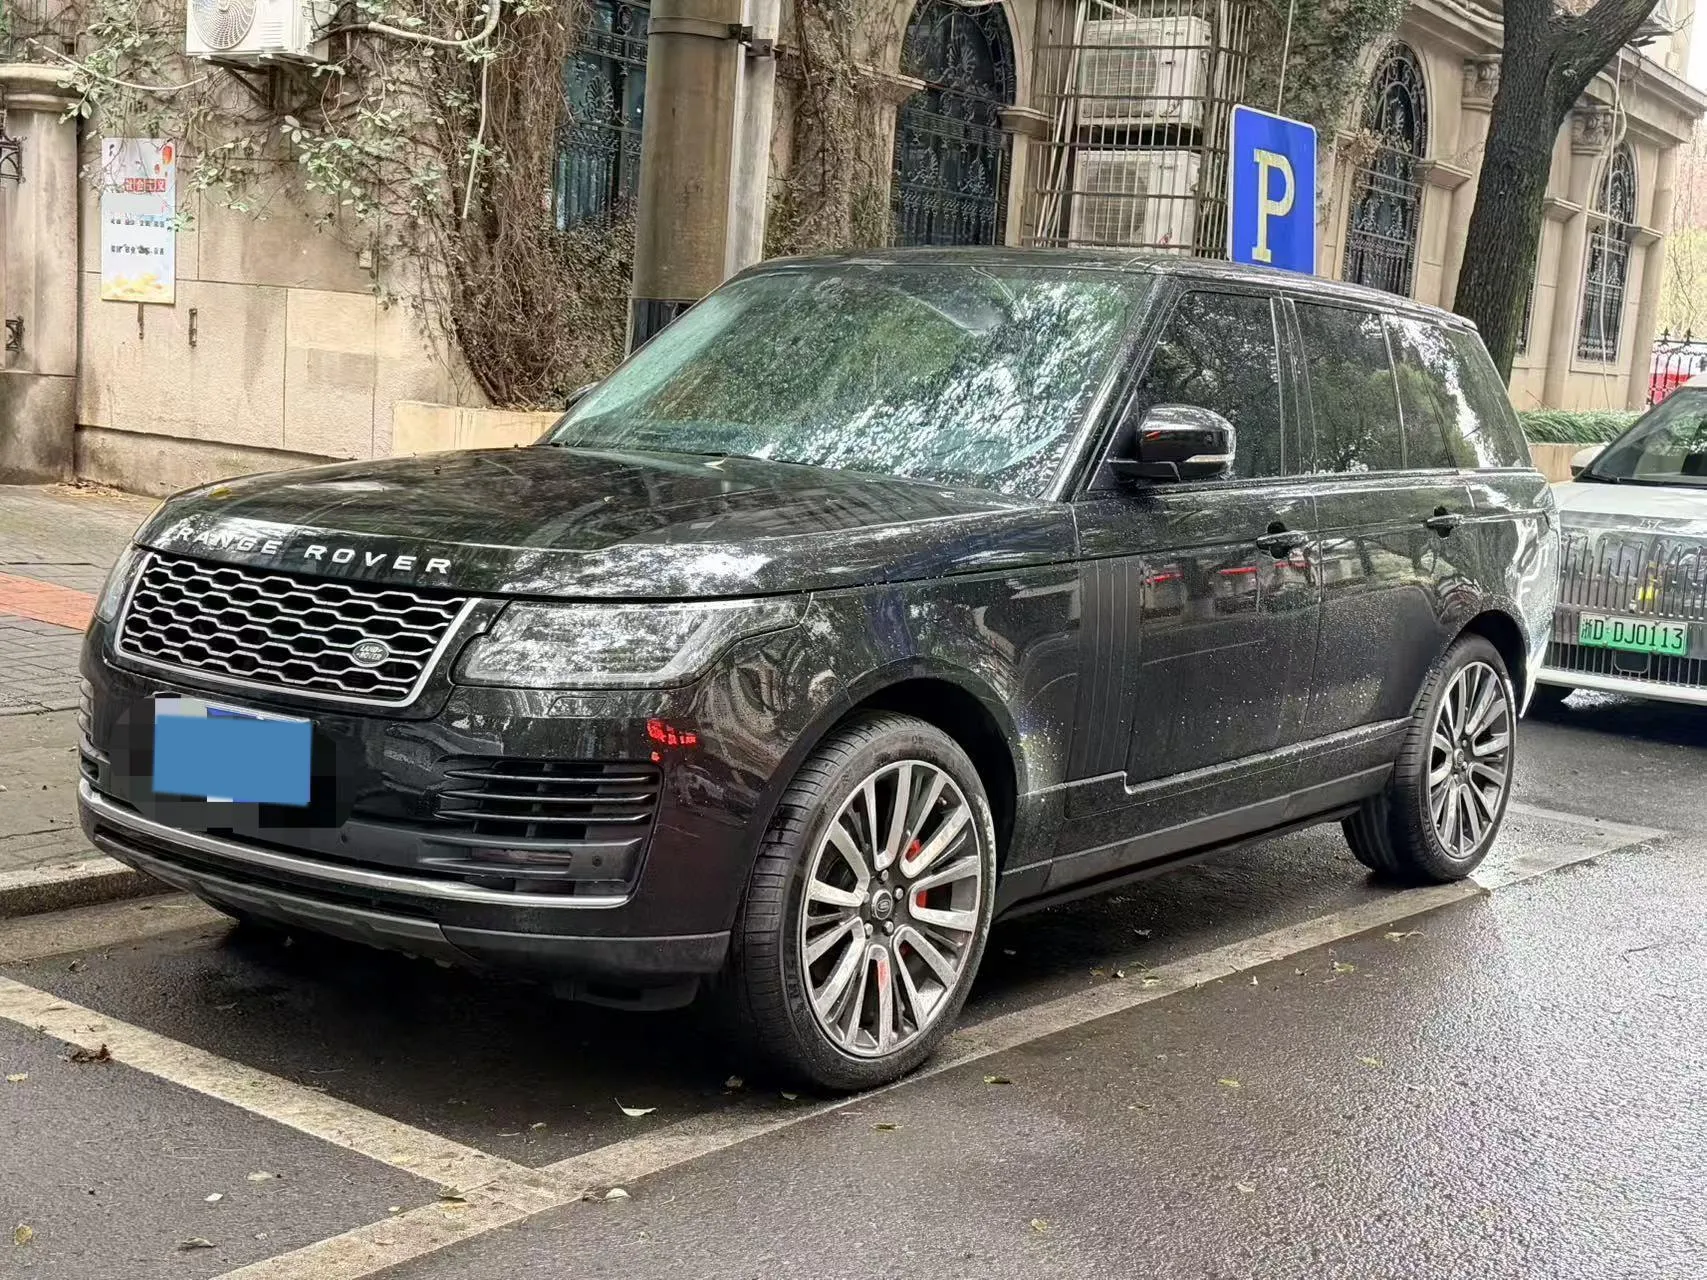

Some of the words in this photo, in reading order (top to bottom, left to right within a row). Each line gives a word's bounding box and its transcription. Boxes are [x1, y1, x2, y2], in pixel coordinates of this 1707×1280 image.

[1252, 148, 1295, 263] P
[174, 526, 284, 555] RANGE
[303, 544, 452, 574] ROVER
